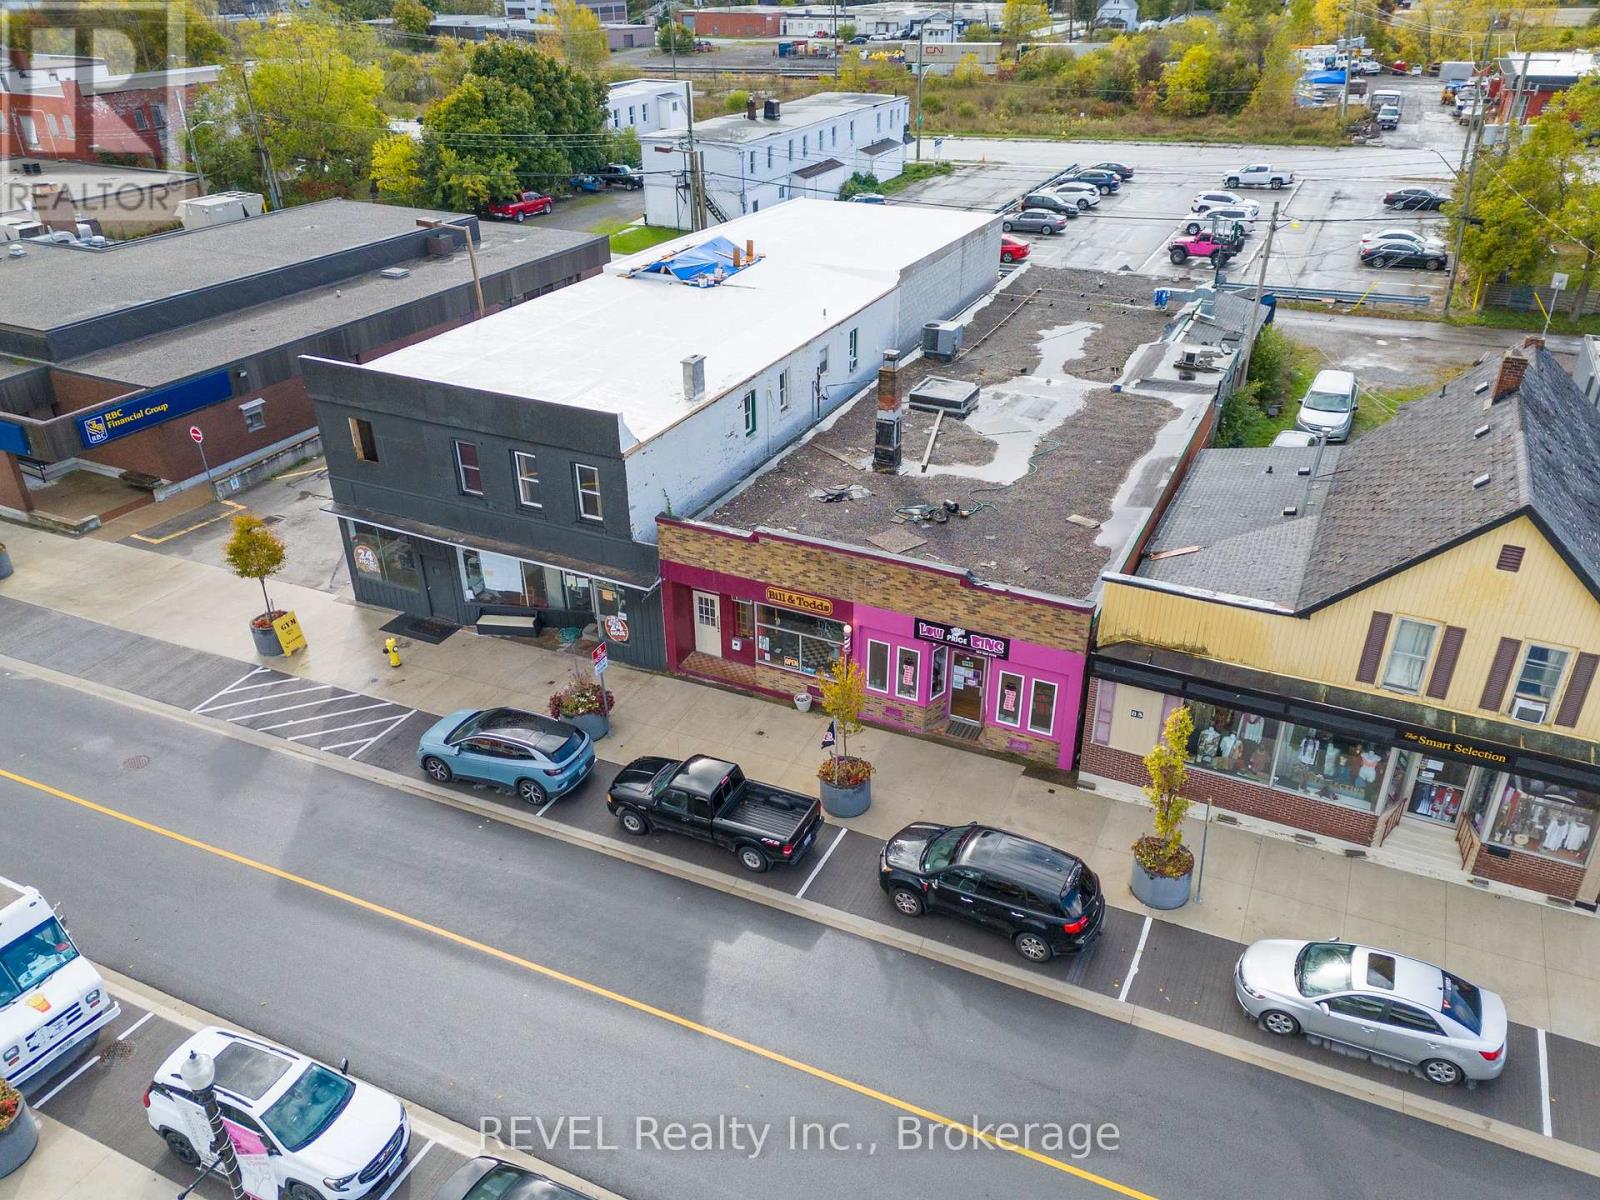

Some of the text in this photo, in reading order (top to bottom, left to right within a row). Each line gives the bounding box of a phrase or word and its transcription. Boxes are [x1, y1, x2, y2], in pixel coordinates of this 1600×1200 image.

[925, 46, 944, 54] CN
[104, 409, 123, 421] RBC
[107, 403, 169, 429] Financial Group
[91, 433, 106, 442] RBC
[768, 590, 830, 612] Bill & Todds
[281, 618, 297, 631] GYM
[919, 622, 945, 640] LOW
[946, 634, 968, 645] PRICE
[1404, 731, 1506, 763] The Smart Selection
